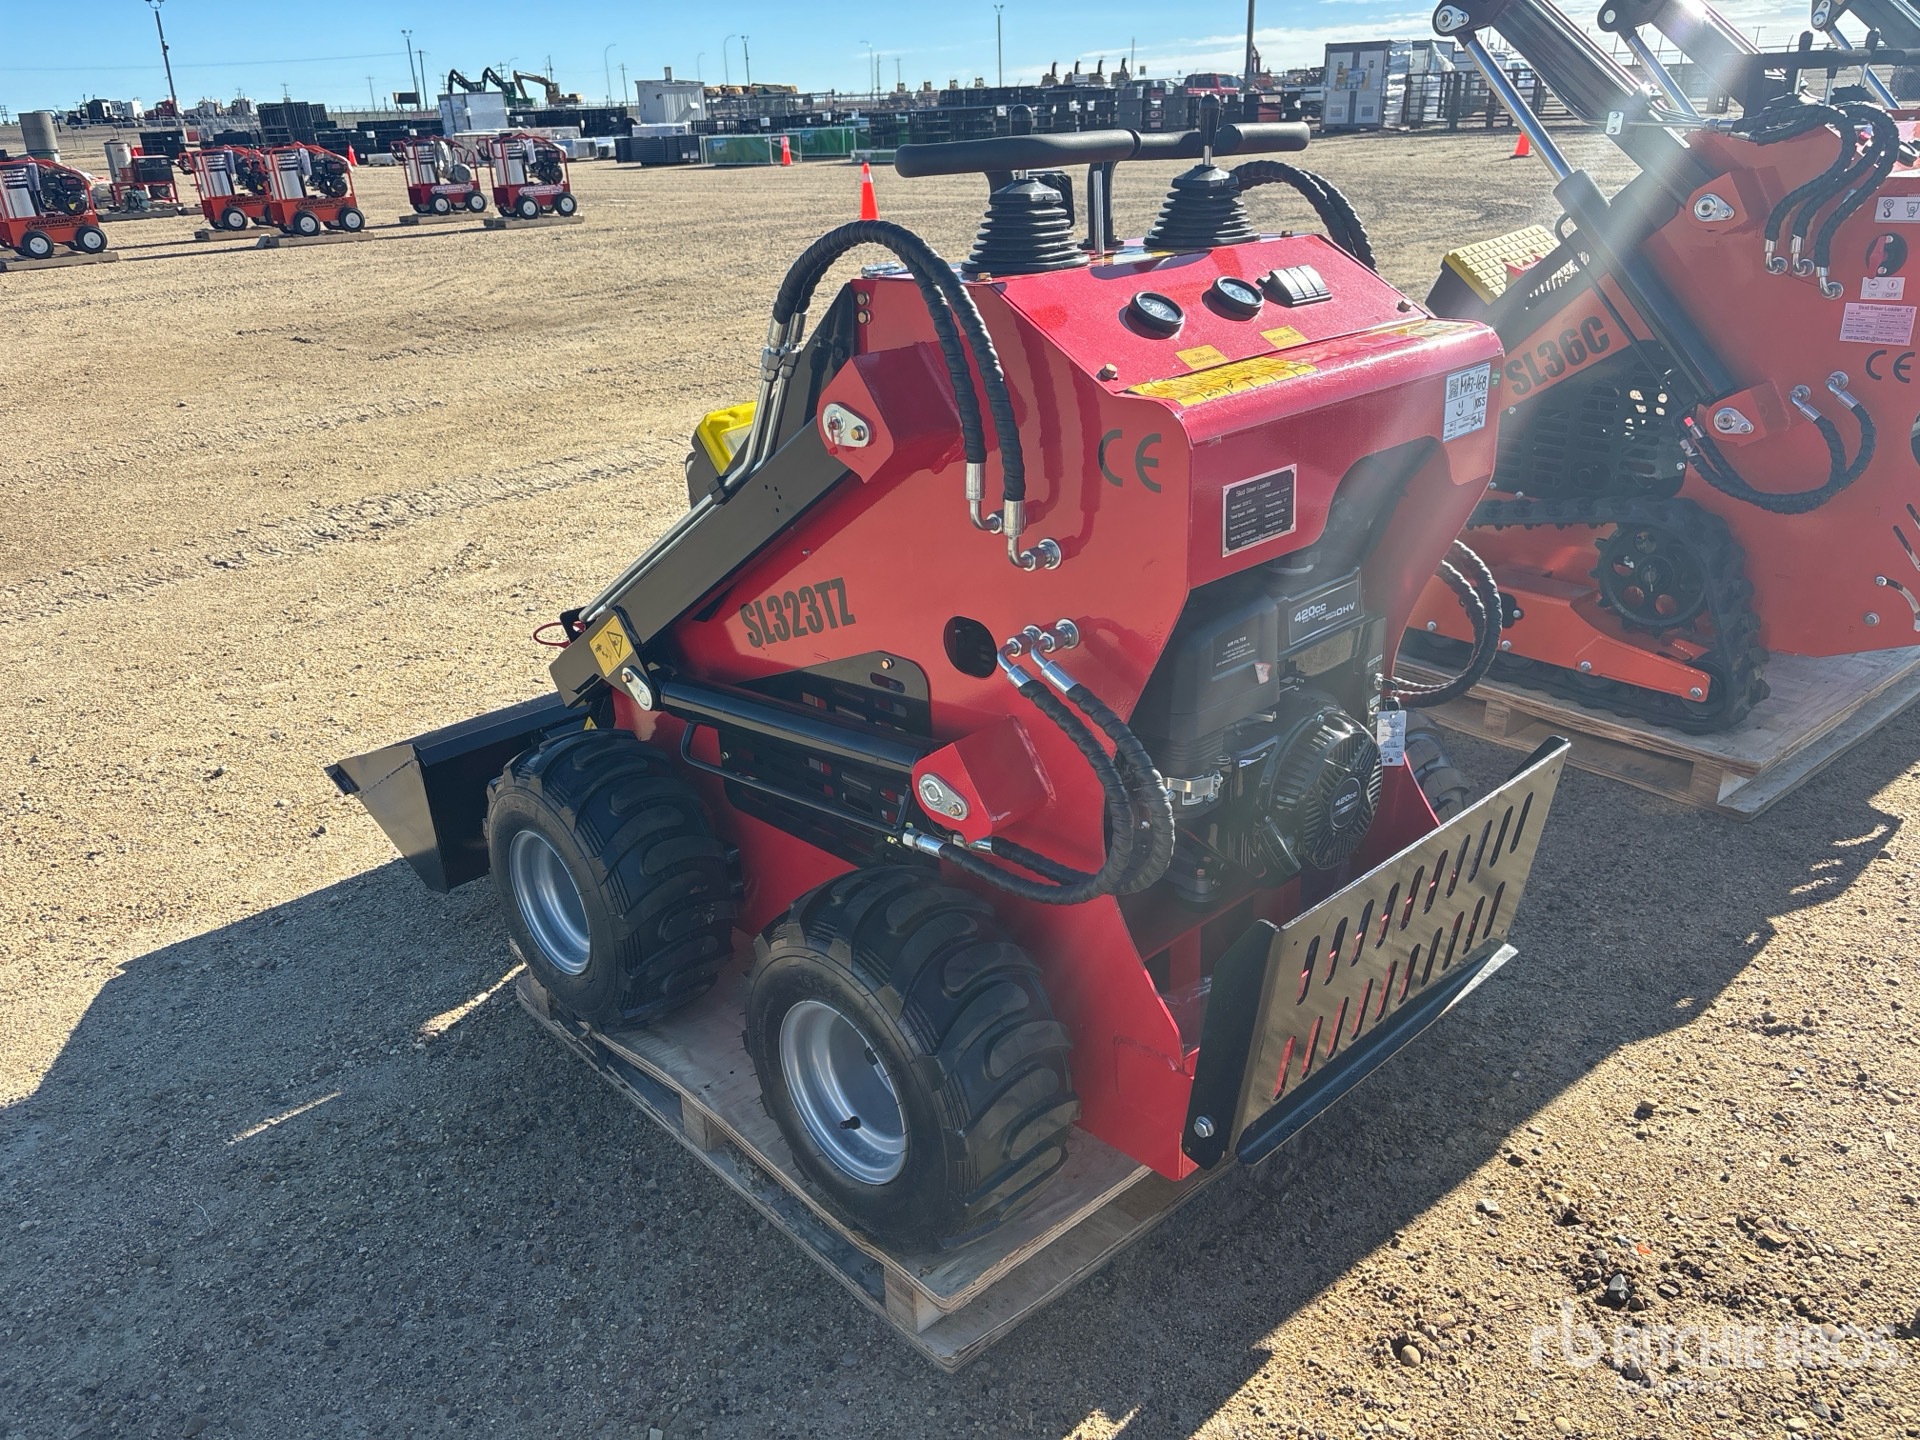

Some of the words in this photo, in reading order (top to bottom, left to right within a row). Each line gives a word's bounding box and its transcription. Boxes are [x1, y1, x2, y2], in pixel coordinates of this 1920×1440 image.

[1504, 315, 1611, 396] SL36C
[740, 577, 856, 648] SL323TZ
[1294, 602, 1327, 623] 420cc
[1336, 601, 1356, 616] OHV
[1335, 791, 1358, 807] 420cc
